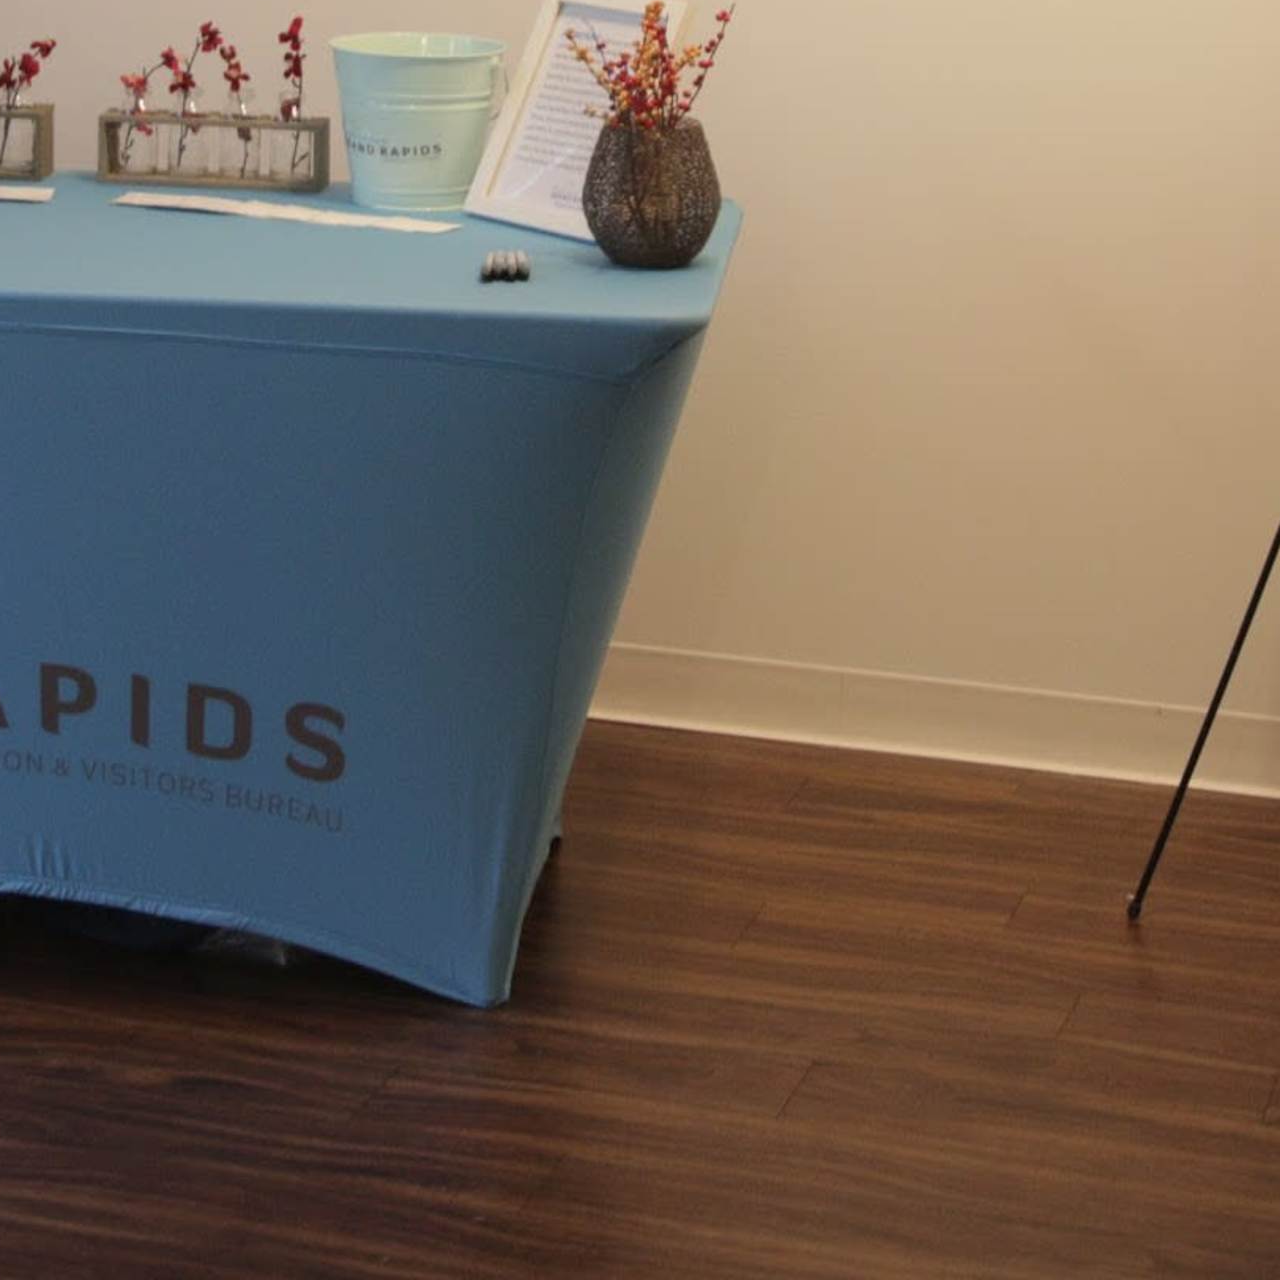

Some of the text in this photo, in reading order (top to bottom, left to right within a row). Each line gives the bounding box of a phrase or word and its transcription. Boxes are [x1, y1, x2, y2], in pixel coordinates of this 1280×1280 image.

[380, 144, 442, 157] RAPIDS
[54, 759, 70, 776] &
[80, 760, 216, 803] VISITORS
[226, 783, 343, 833] BUREAU
